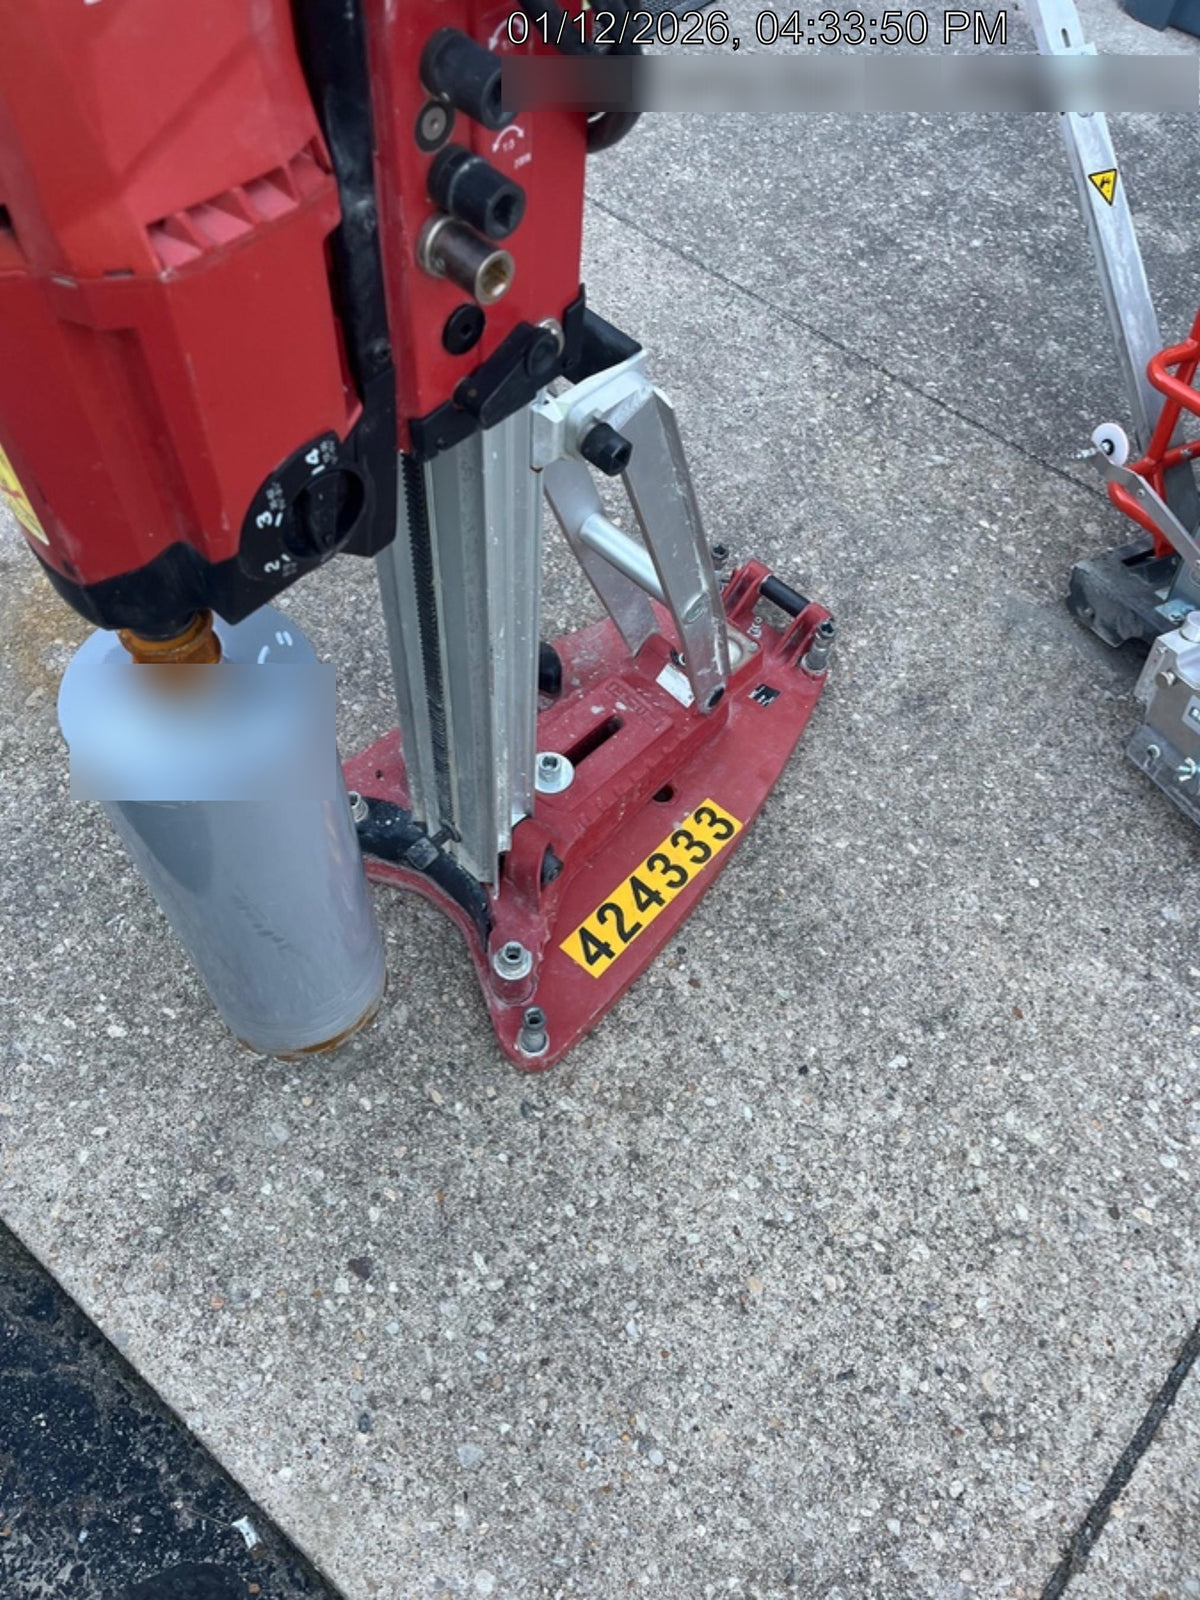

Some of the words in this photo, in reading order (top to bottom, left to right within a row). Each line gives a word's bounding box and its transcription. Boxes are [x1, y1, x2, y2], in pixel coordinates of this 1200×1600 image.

[305, 448, 320, 465] 4
[255, 511, 273, 529] 3
[264, 559, 281, 573] 2
[578, 806, 735, 966] 424333
